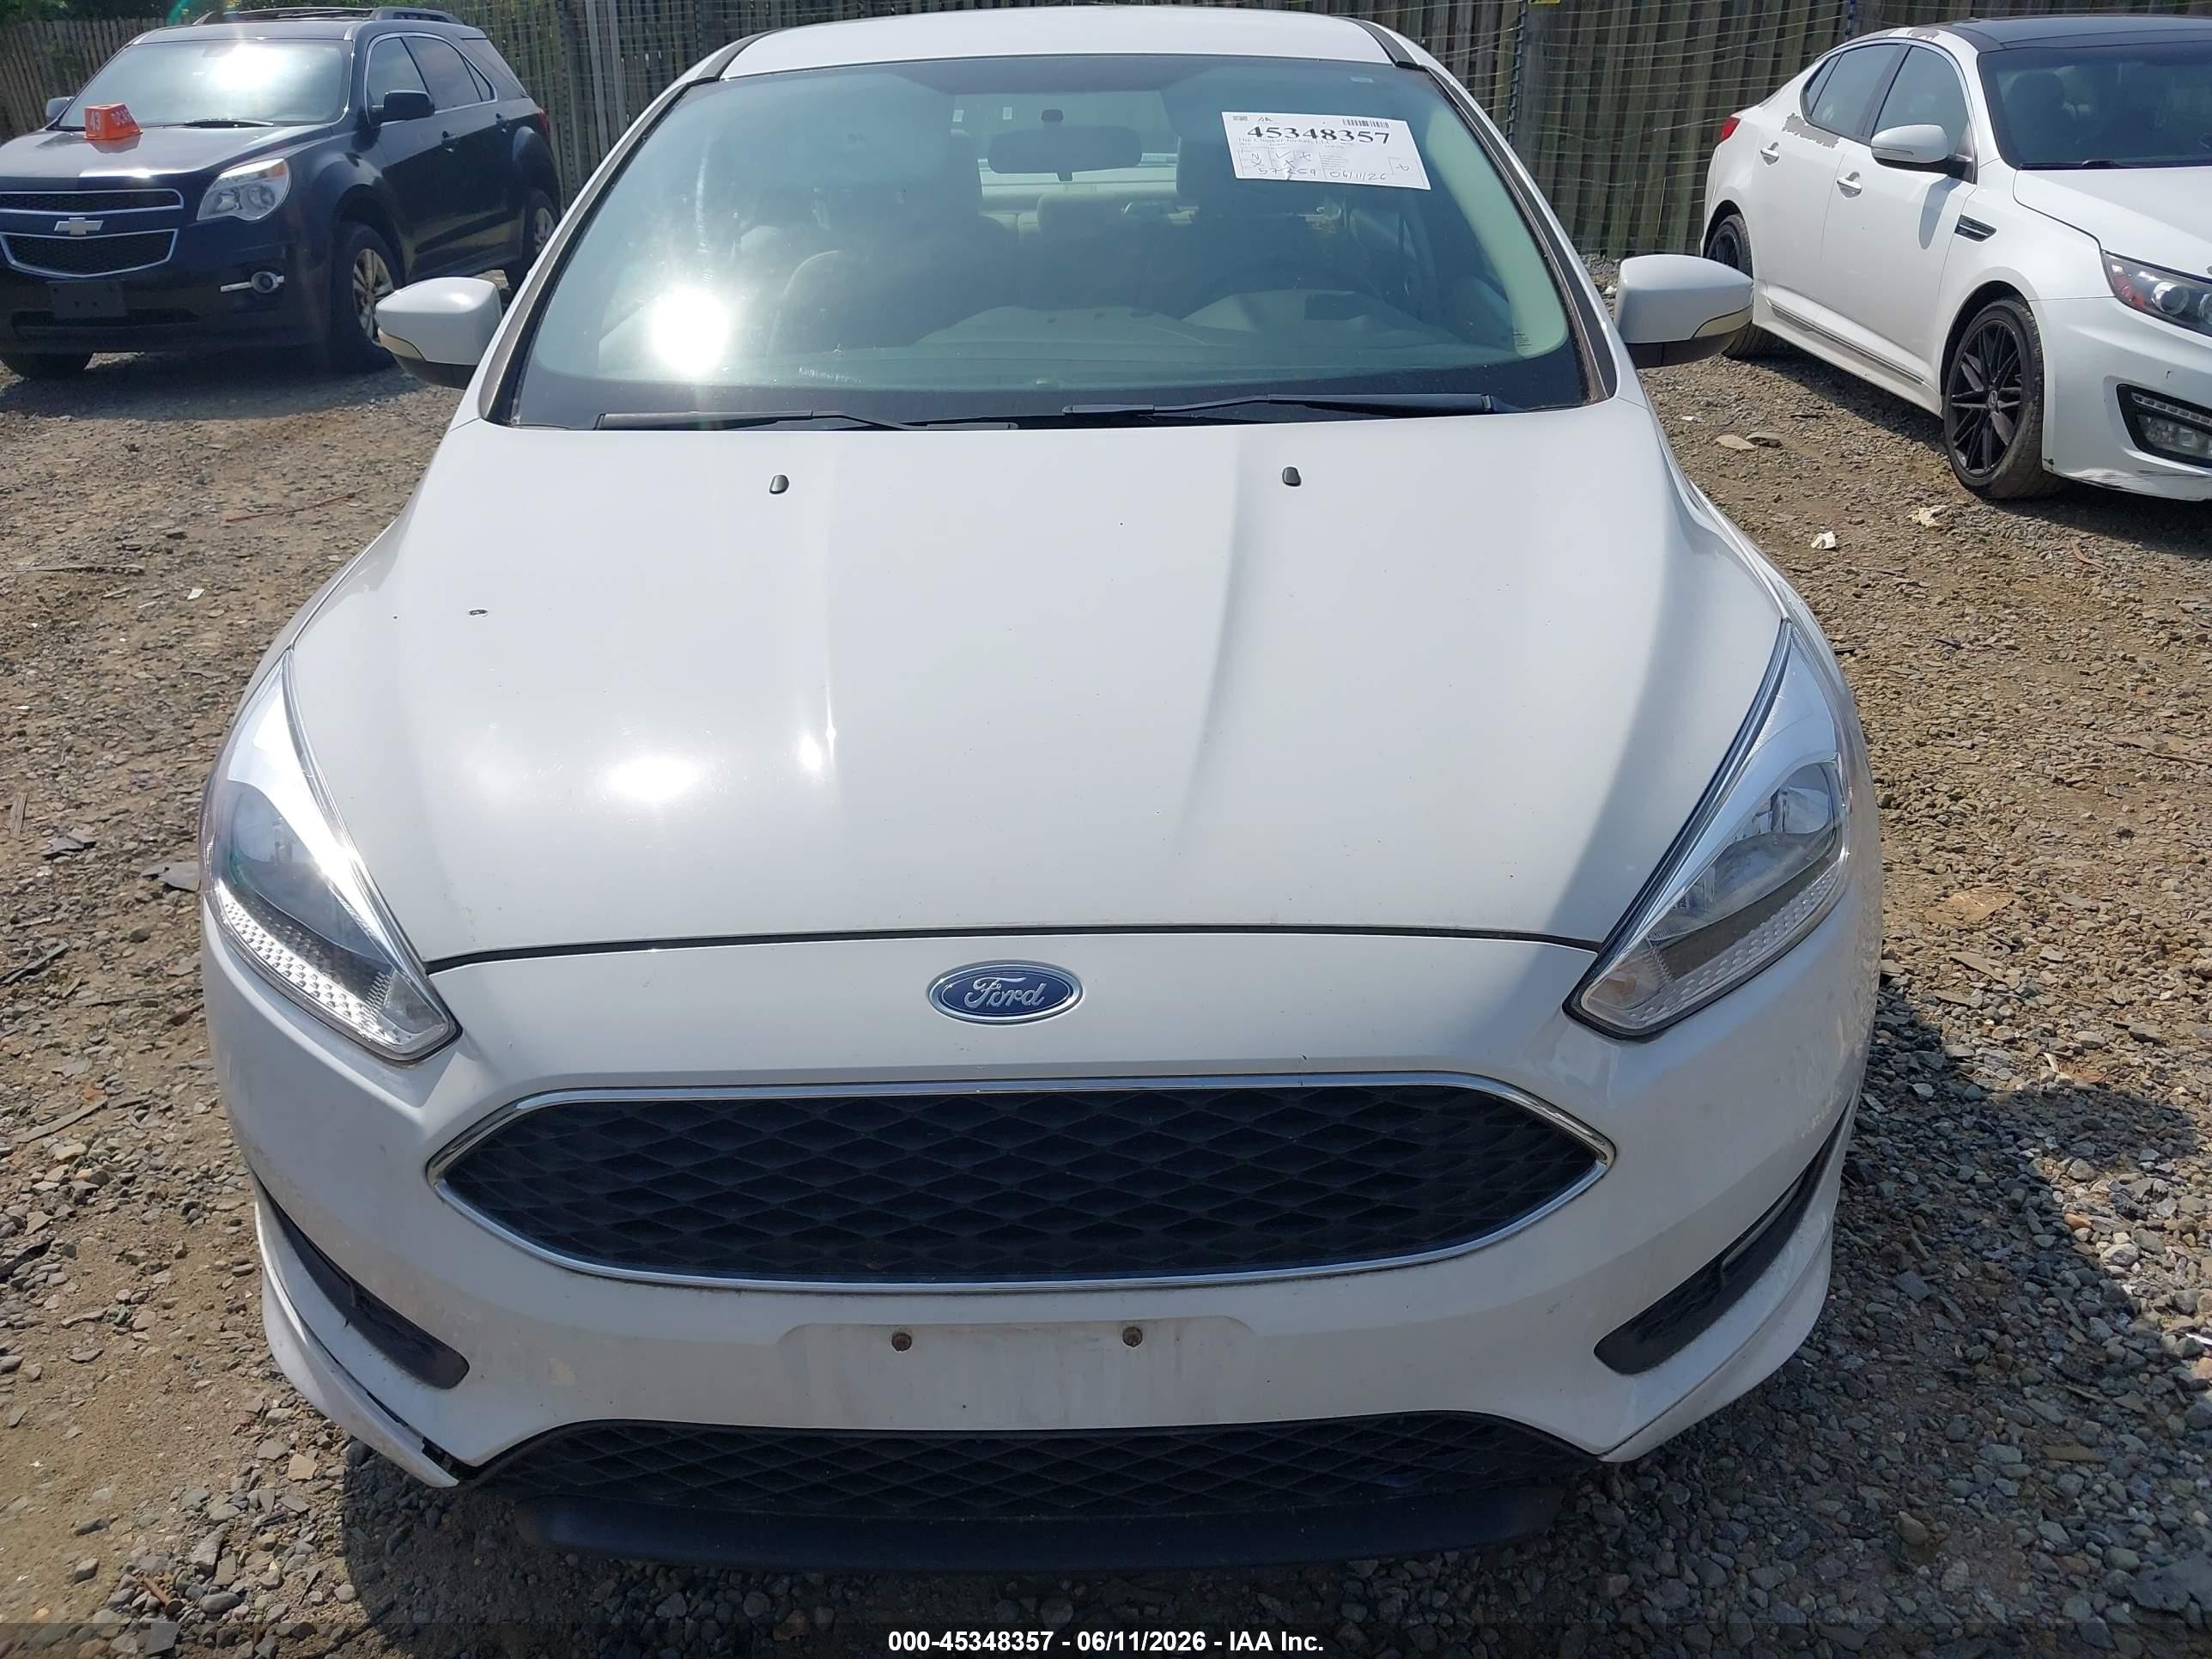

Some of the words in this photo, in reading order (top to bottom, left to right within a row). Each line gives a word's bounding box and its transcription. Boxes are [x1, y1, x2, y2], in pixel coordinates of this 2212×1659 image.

[90, 110, 101, 131] 43
[1247, 125, 1390, 144] 45348357
[963, 977, 1048, 1008] Ford
